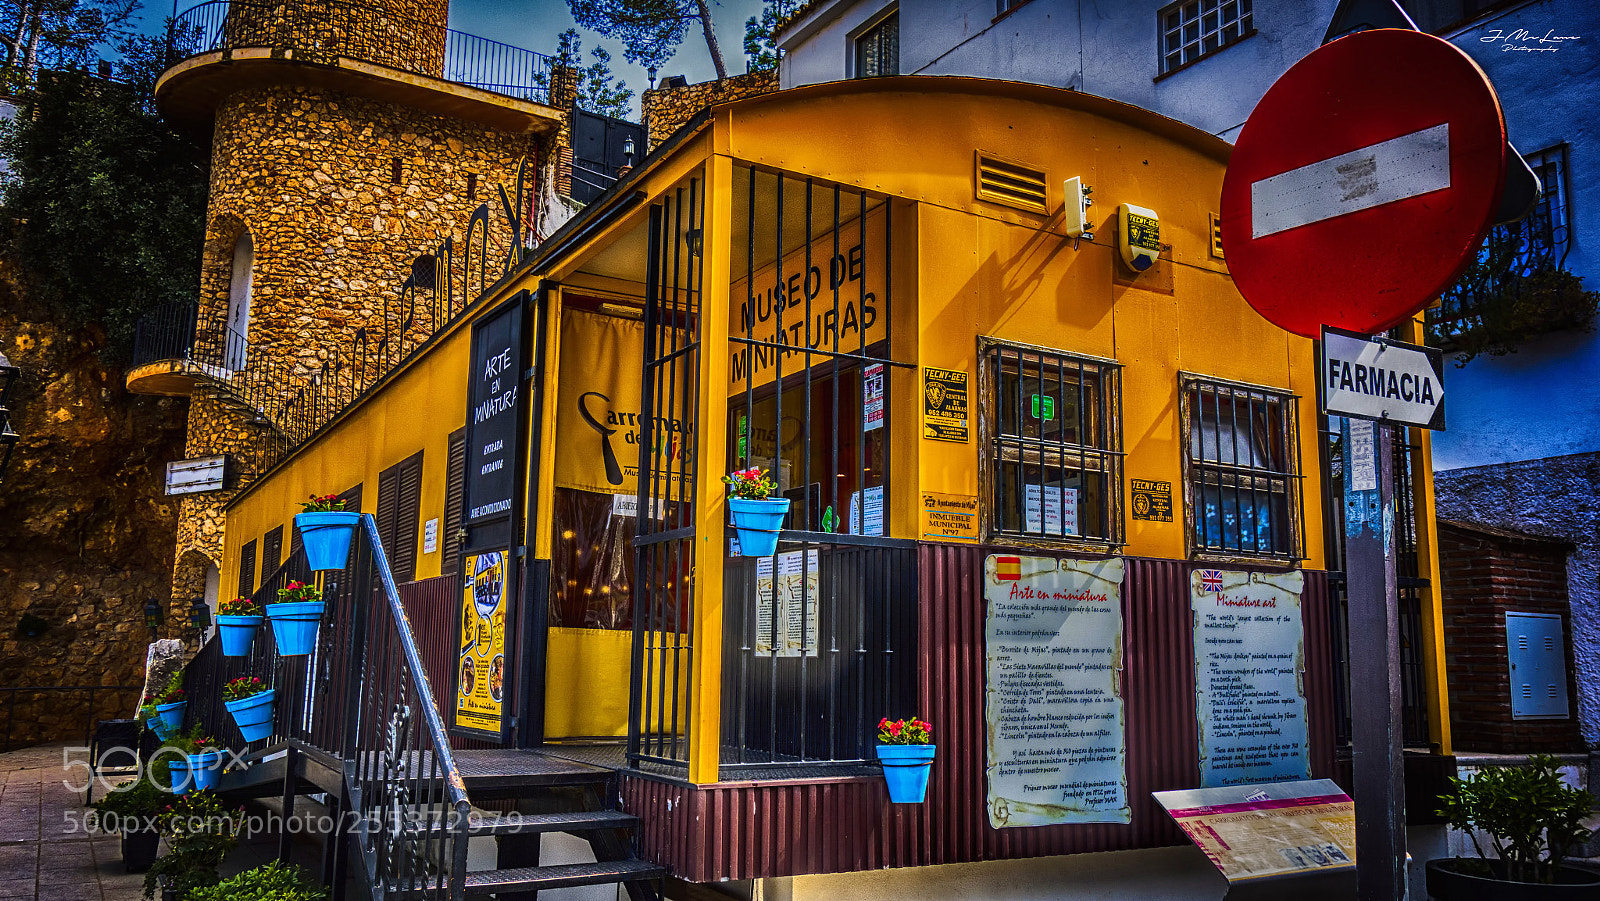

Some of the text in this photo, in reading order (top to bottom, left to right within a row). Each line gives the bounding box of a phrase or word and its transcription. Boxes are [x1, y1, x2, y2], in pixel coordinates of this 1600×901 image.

[741, 243, 865, 333] MUSEO DE
[732, 292, 876, 384] MNIATURAS
[484, 348, 512, 382] ARTE
[926, 368, 966, 382] TECNY-GES
[1328, 358, 1435, 406] FARMACIA
[492, 378, 500, 394] EN
[1132, 480, 1170, 491] TECNY-GES
[929, 520, 972, 529] MUNICIPAL
[930, 513, 970, 522] INMUEBLE
[1010, 582, 1108, 602] Arte en miniatura
[1217, 592, 1276, 608] Miniature art
[1007, 602, 1029, 610] colección
